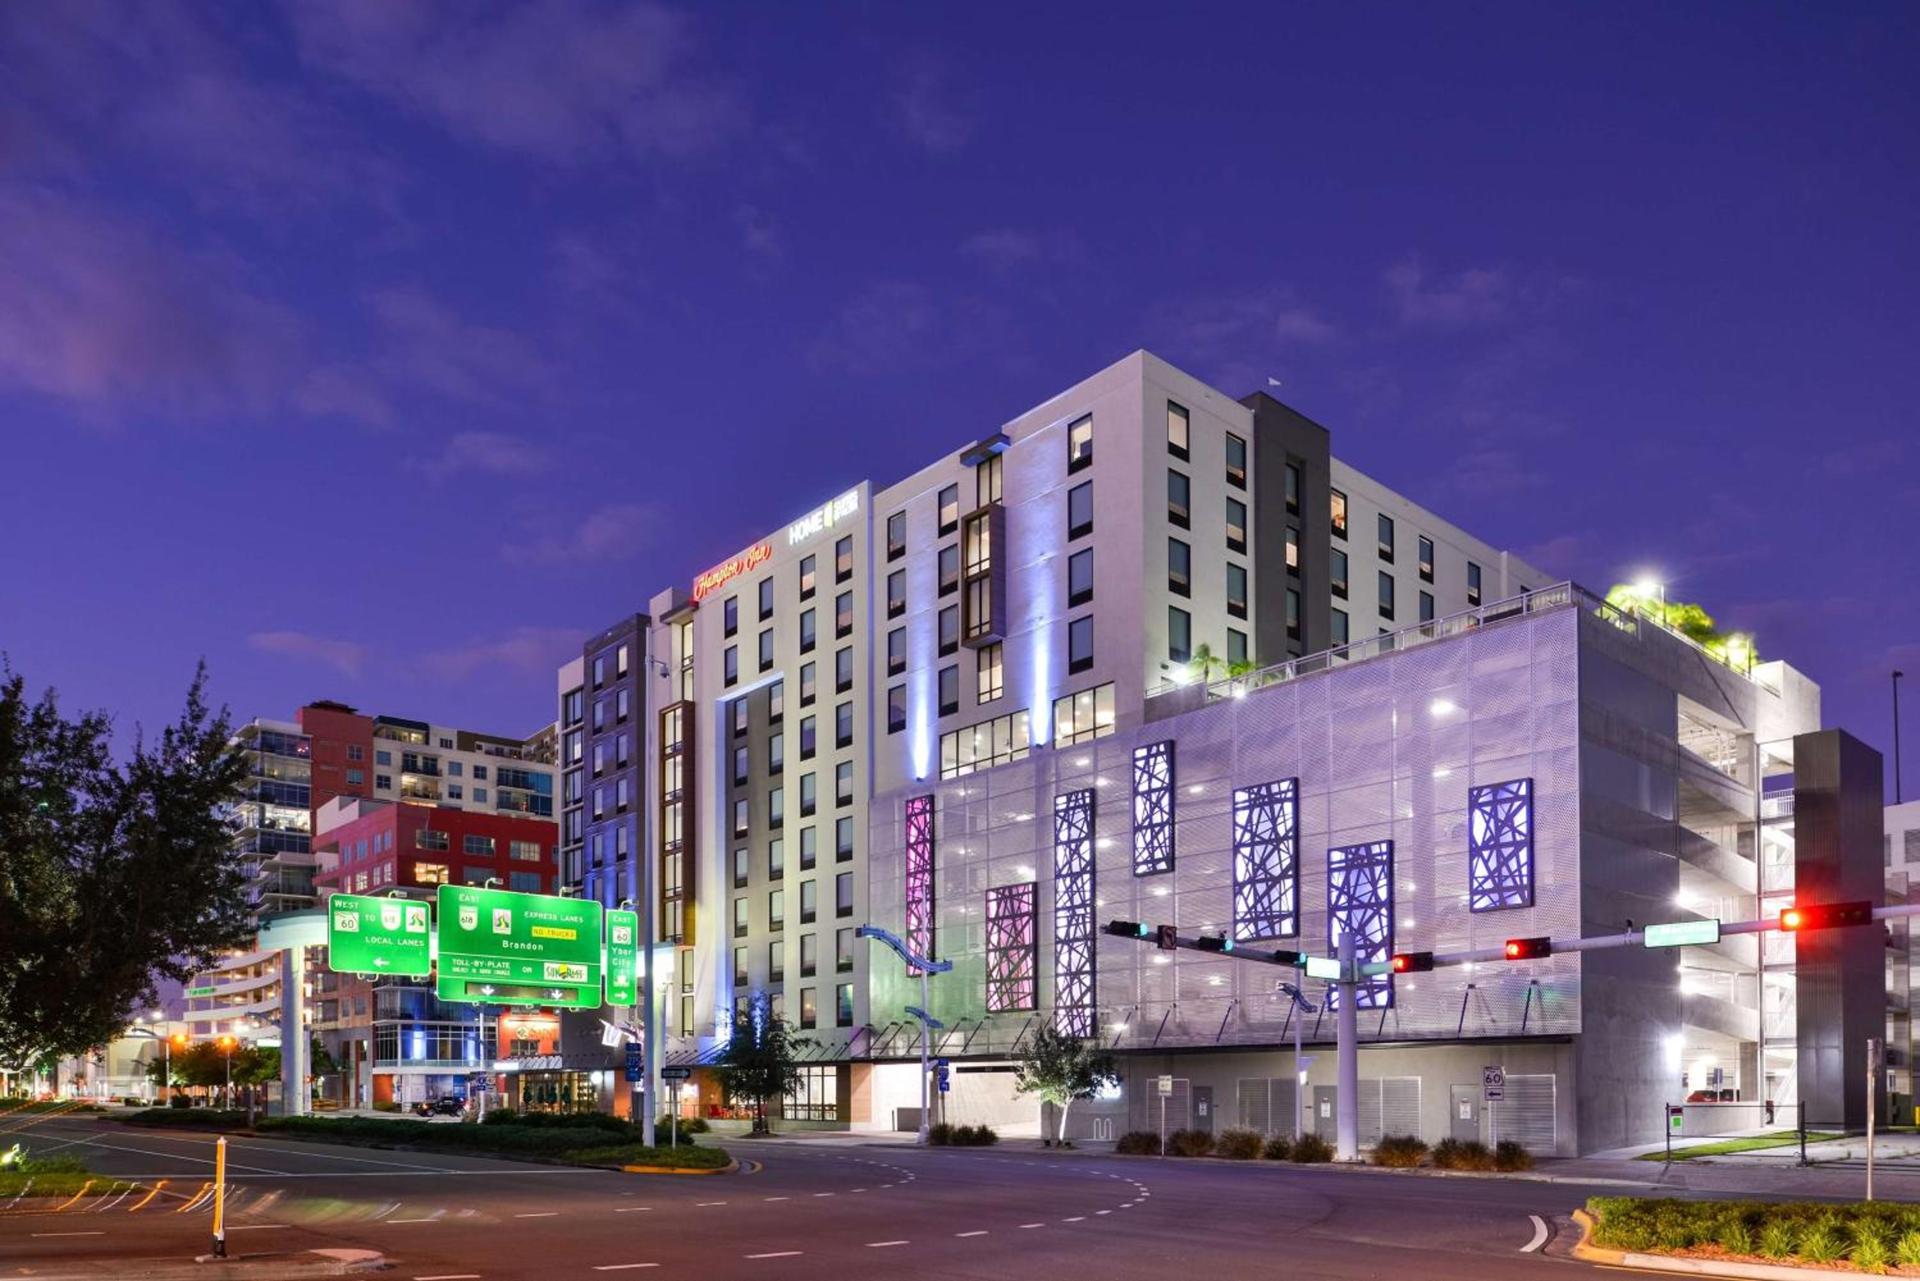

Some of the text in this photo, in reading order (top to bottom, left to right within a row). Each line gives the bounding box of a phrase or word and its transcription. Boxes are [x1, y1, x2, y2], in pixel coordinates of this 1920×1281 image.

[789, 510, 824, 545] HOME
[334, 900, 359, 910] WEST
[341, 919, 355, 929] 60
[365, 914, 376, 922] TO
[524, 911, 584, 923] EXPRESS LANES
[365, 936, 424, 947] LOCAL LANES
[502, 940, 544, 951] Brandon
[1486, 1073, 1501, 1083] 60
